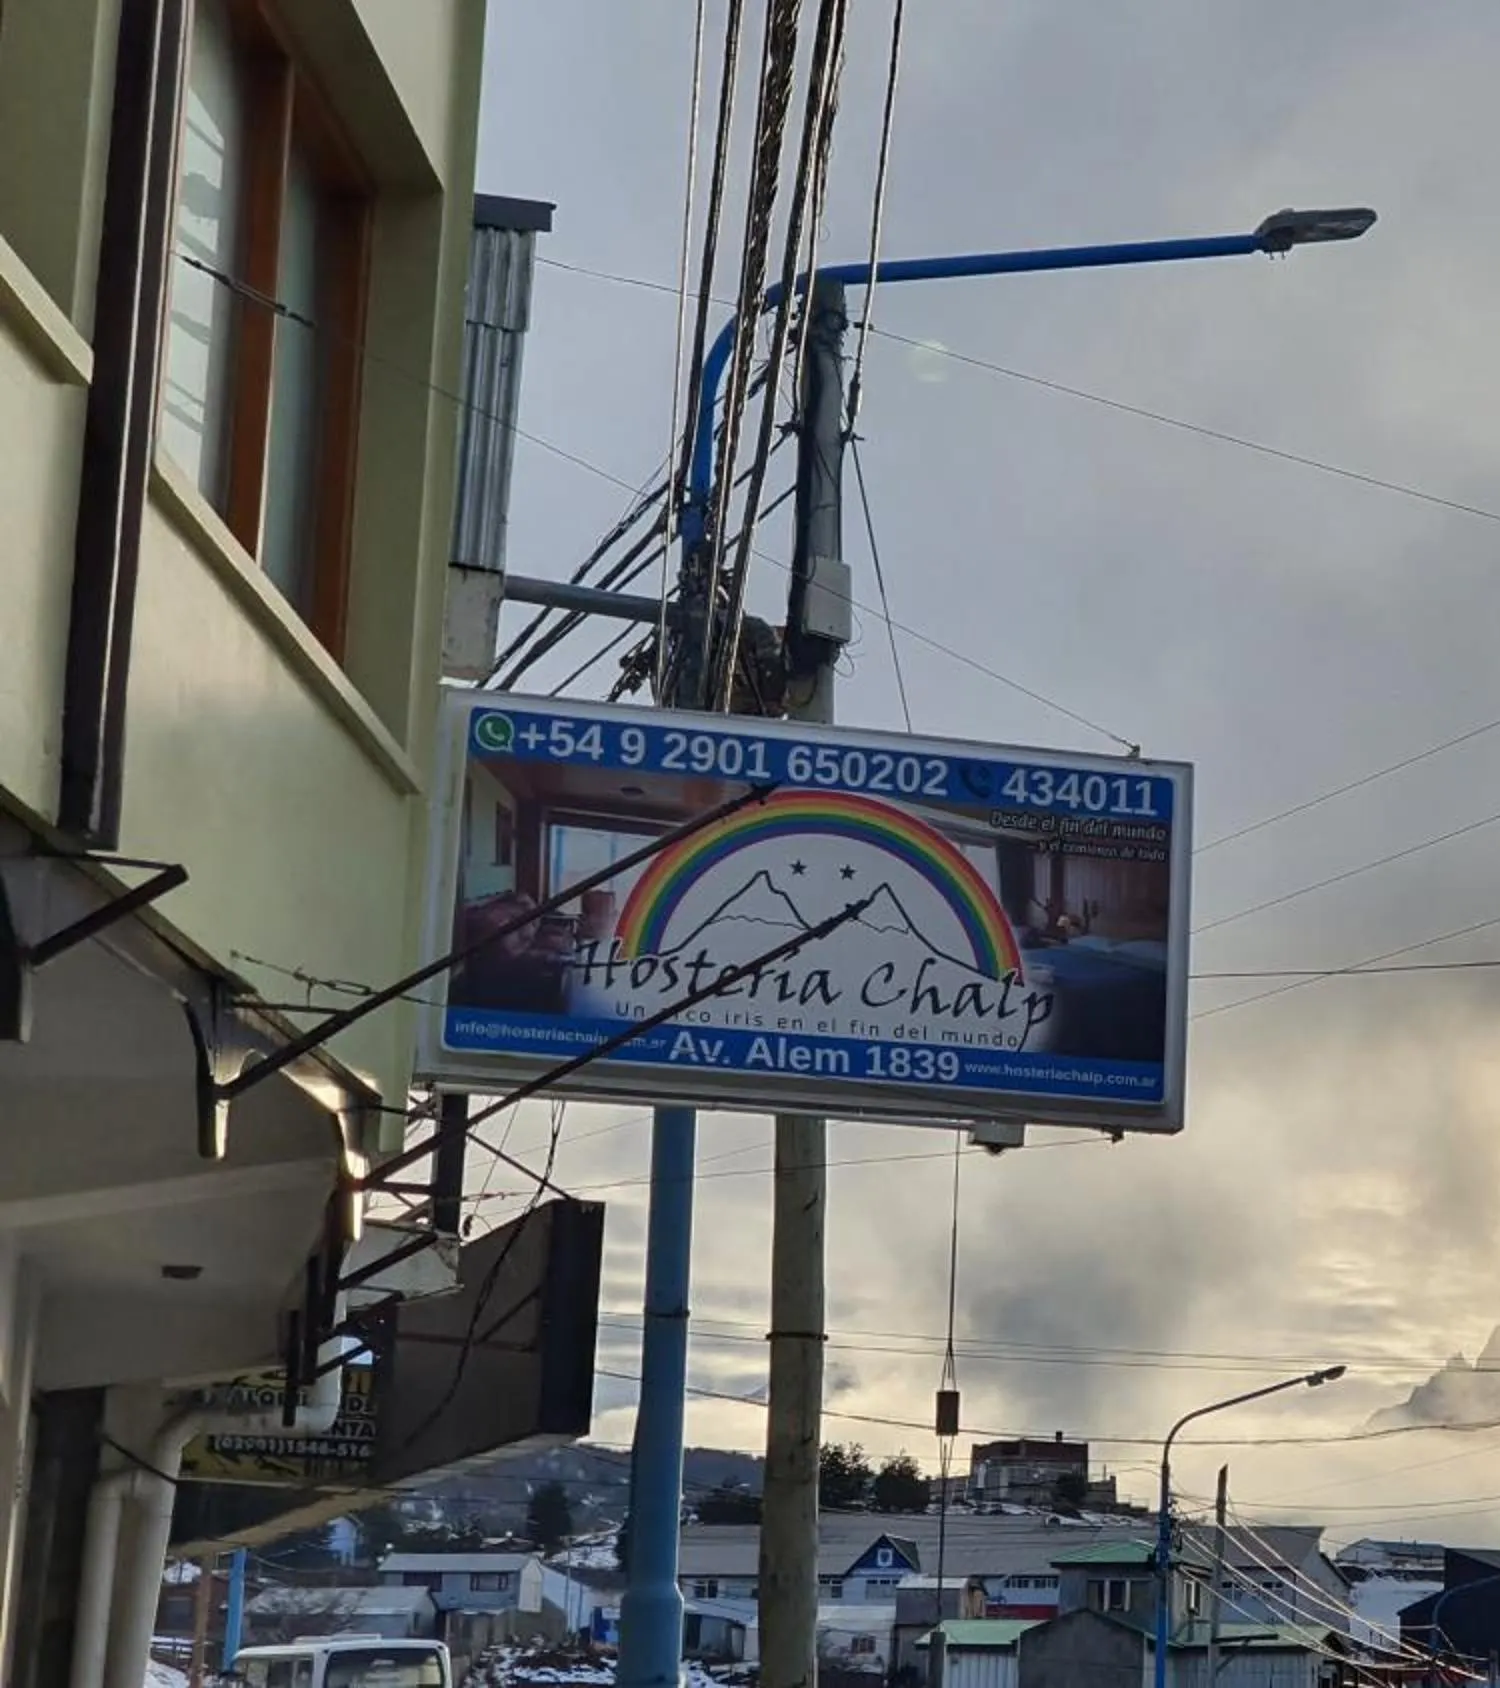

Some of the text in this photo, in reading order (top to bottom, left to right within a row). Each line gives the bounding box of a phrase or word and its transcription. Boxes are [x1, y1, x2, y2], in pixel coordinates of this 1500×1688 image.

[519, 721, 948, 797] +54 9 2901 650202
[1003, 768, 1158, 817] 434011
[991, 810, 1167, 842] Desde el fin del mundo
[615, 1000, 645, 1018] Un
[724, 1009, 764, 1027] iris
[777, 1016, 803, 1031] en
[816, 1017, 837, 1034] el
[849, 1018, 880, 1037] fin
[892, 1022, 928, 1041] del
[941, 1027, 1019, 1048] mundo
[861, 957, 1056, 1053] Chalp
[454, 1022, 668, 1049] info@hosteriachalpom.ar
[669, 1031, 960, 1082] Av. Alem 1839
[964, 1060, 1157, 1089] www.hosteriachalp.com.ar
